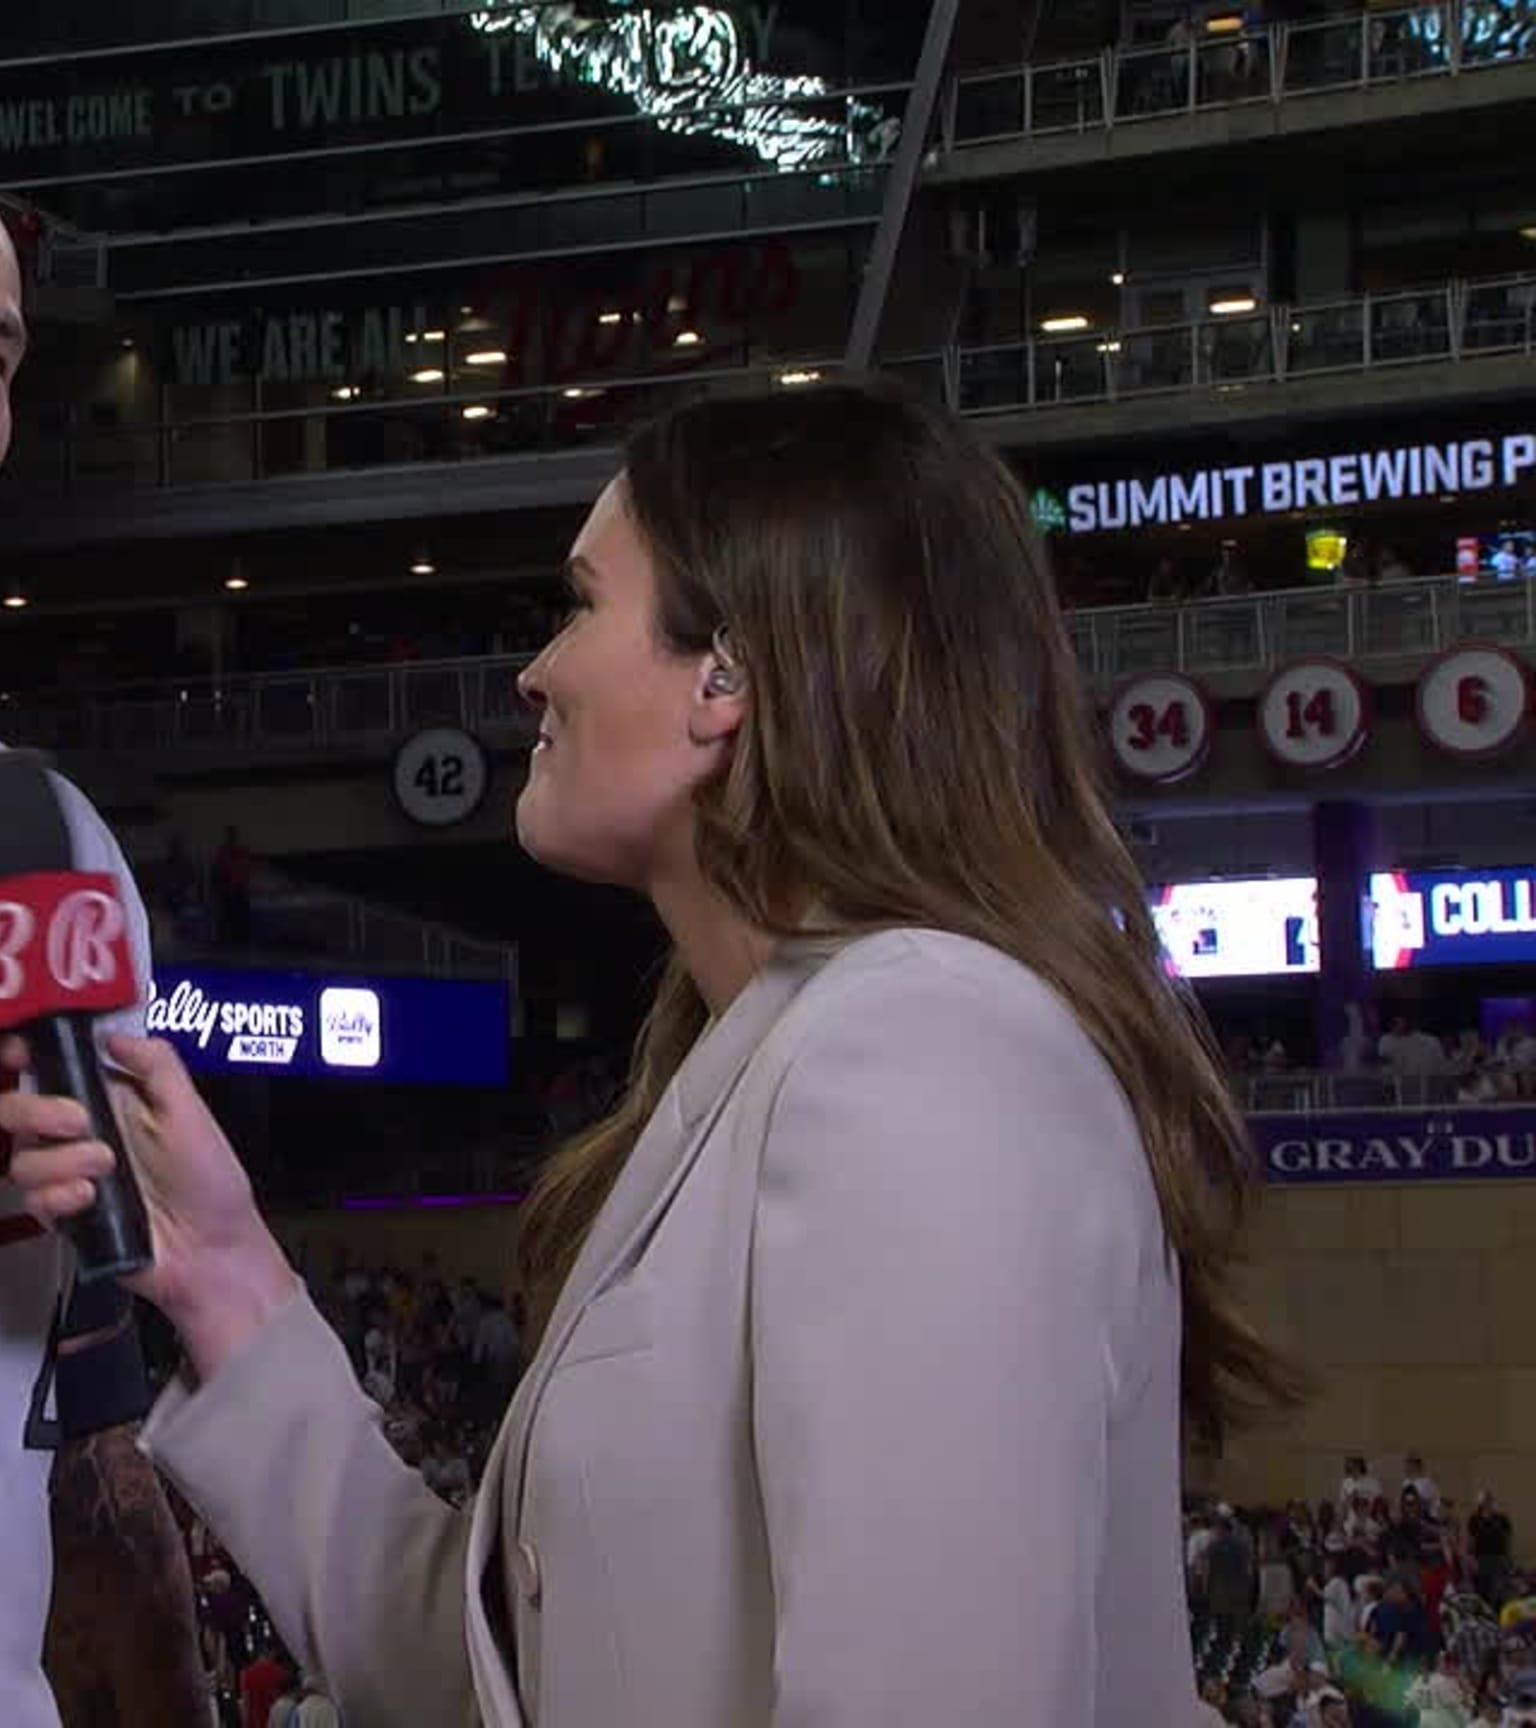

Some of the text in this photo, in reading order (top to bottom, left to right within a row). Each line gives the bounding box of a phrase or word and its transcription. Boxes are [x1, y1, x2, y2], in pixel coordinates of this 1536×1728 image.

[0, 91, 154, 152] WELCOME
[173, 83, 234, 116] TO
[268, 46, 442, 131] TWINS
[174, 322, 242, 386] WE
[265, 308, 344, 382] ARE
[1068, 467, 1254, 533] SUMMIT
[1262, 438, 1493, 513] BREWING
[1126, 701, 1189, 751] 34
[1284, 688, 1337, 740] 14
[1455, 674, 1489, 726] 6
[413, 754, 464, 798] 42
[1431, 878, 1536, 936] COLL
[47, 888, 126, 992] B
[219, 1002, 304, 1037] SPORTS
[238, 1040, 286, 1058] NORTH
[1270, 1131, 1536, 1173] GRAY DU
